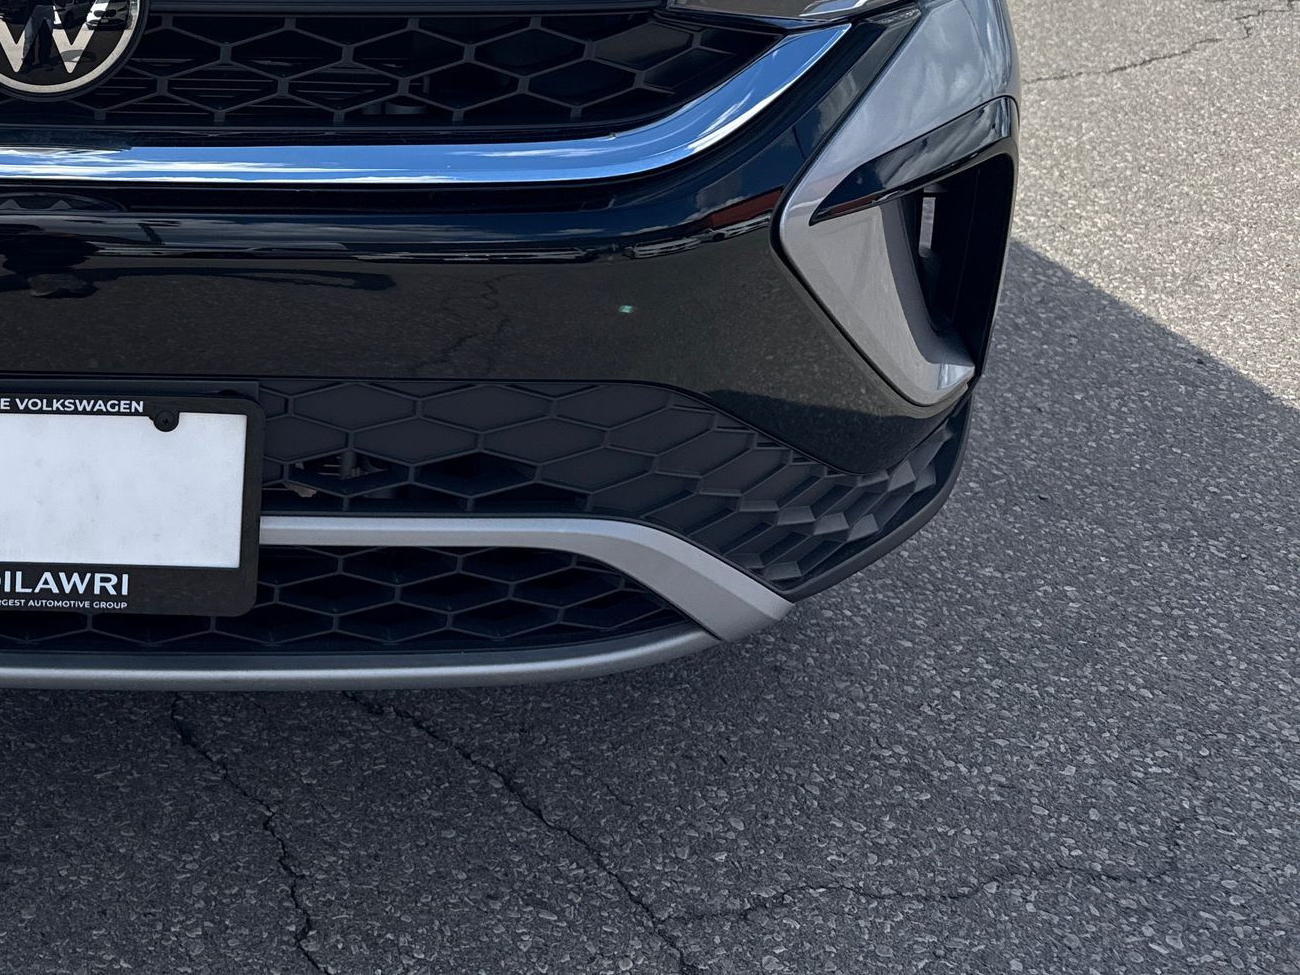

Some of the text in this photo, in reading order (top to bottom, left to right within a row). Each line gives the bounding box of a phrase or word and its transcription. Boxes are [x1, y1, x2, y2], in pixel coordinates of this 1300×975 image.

[15, 398, 144, 413] VOLKSWAGEN
[27, 599, 91, 609] AUTOMOTIVE
[92, 601, 128, 610] GROUP
